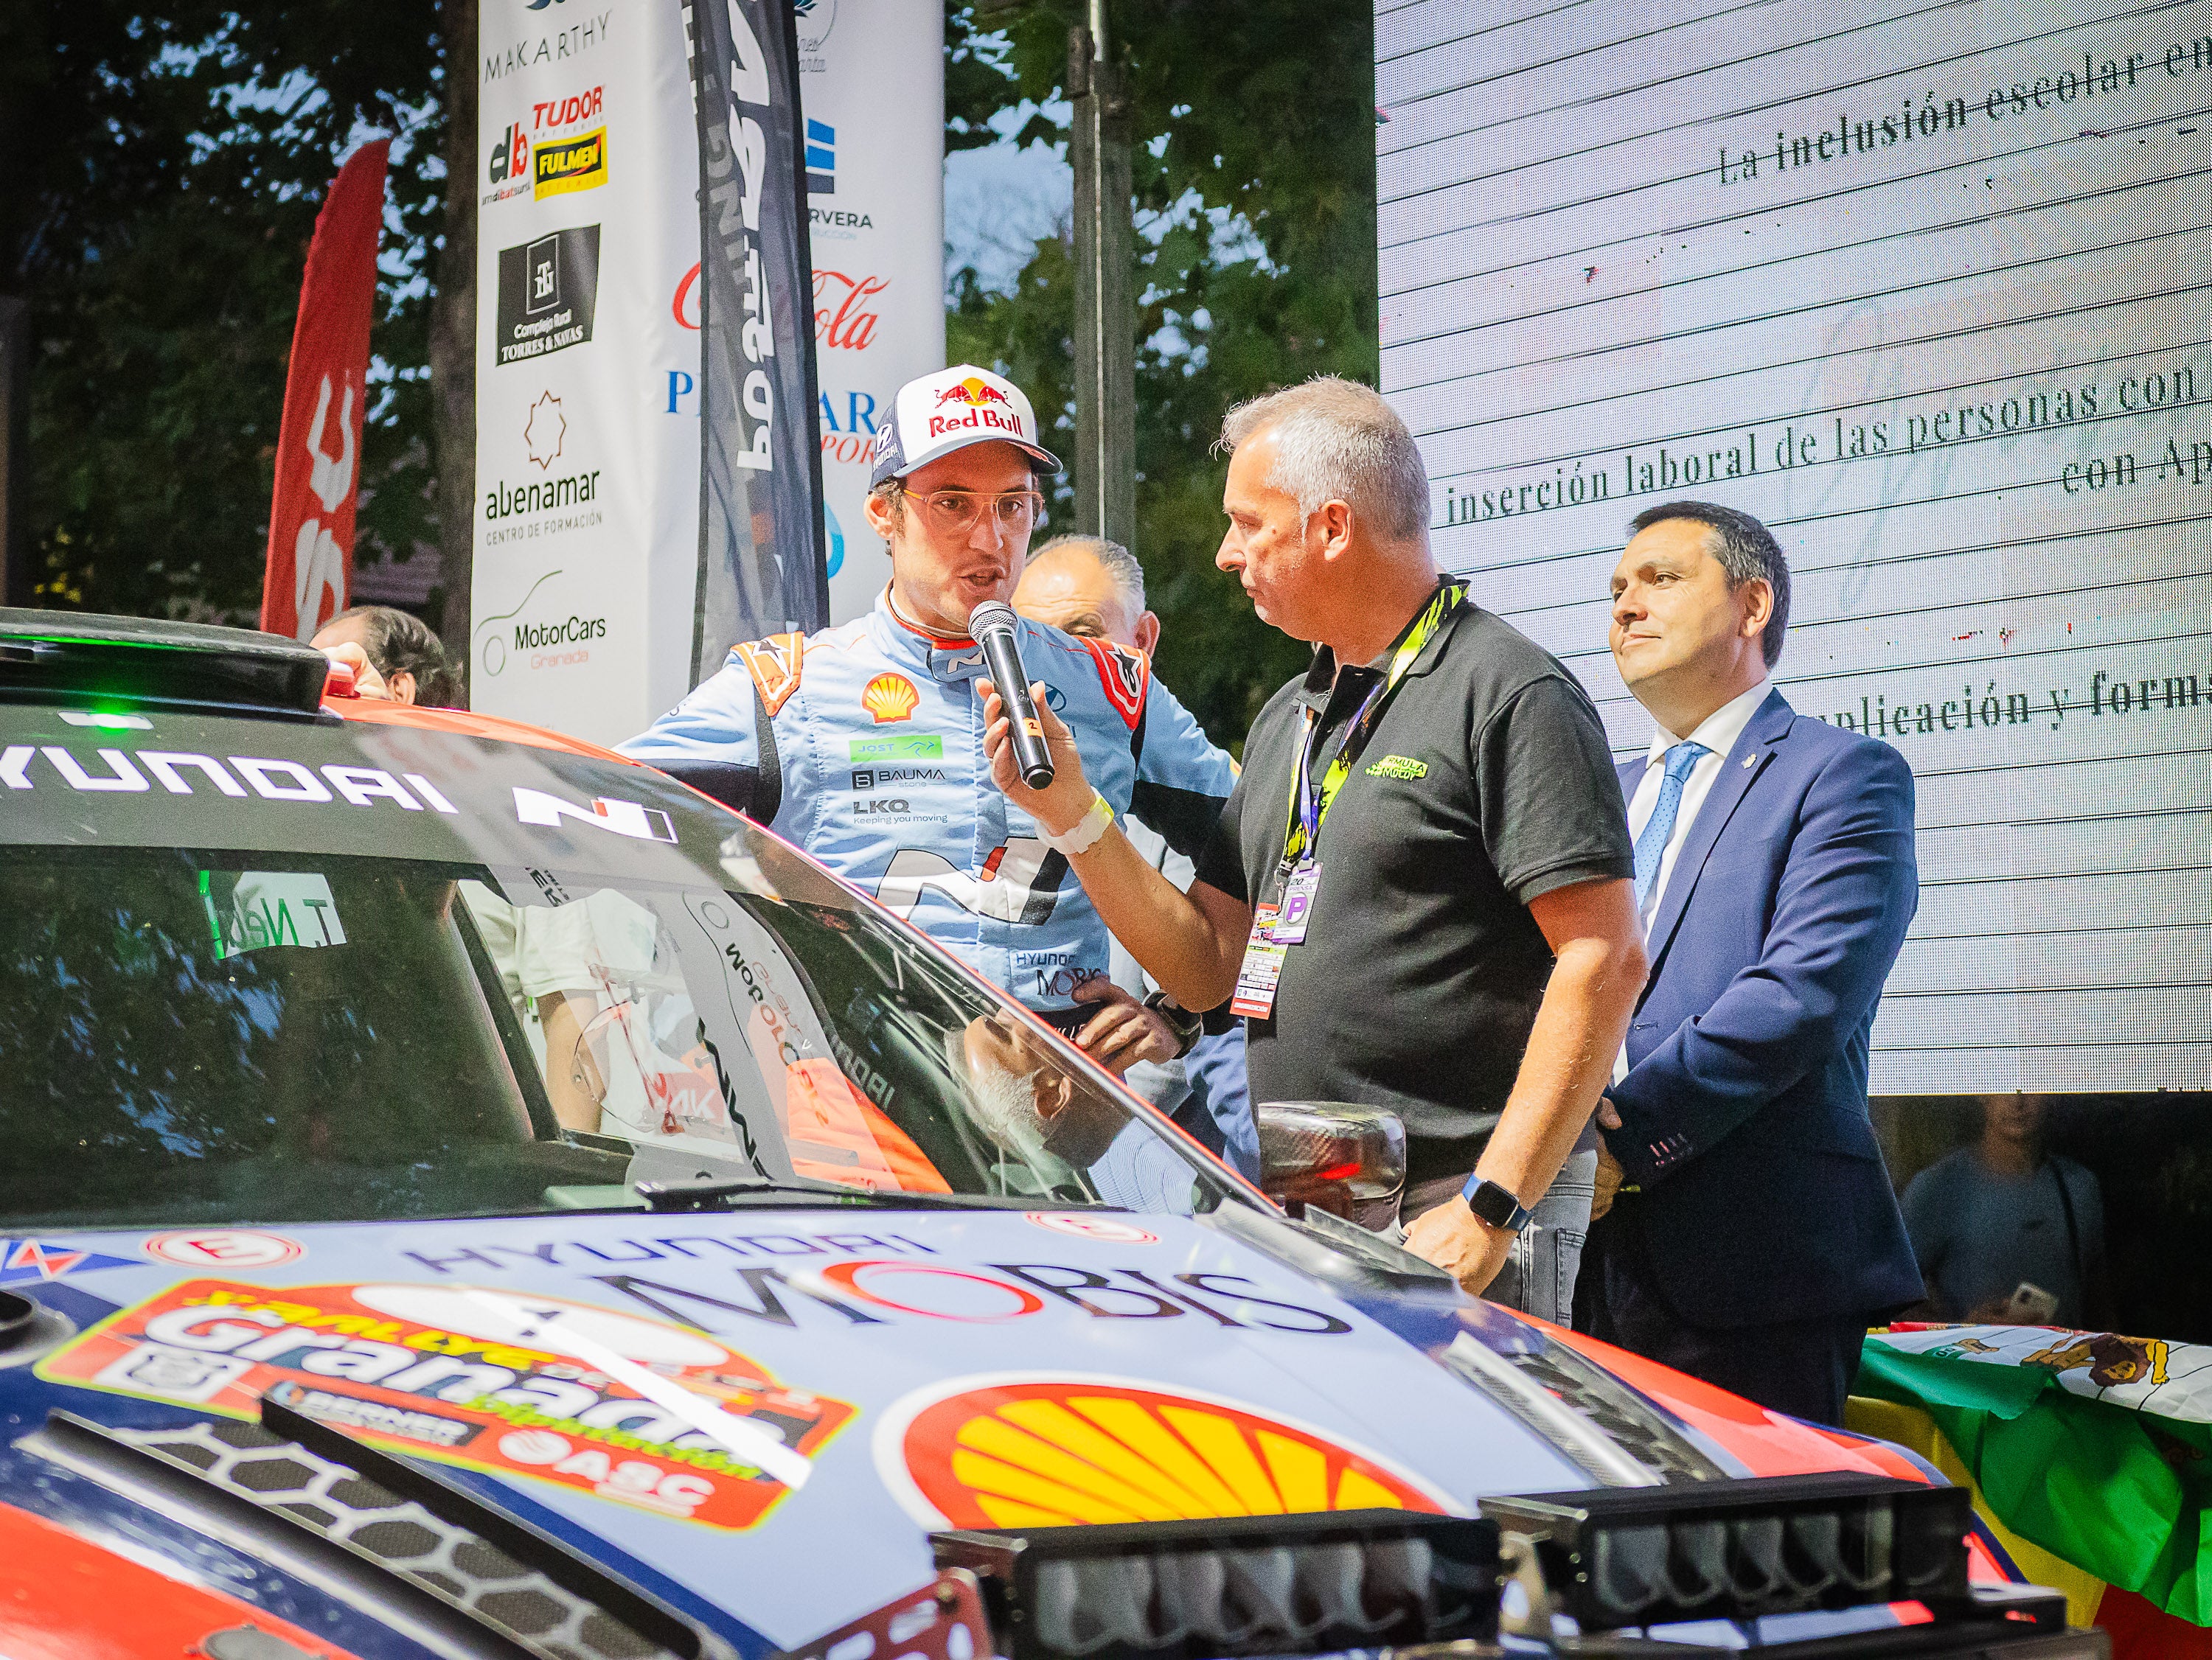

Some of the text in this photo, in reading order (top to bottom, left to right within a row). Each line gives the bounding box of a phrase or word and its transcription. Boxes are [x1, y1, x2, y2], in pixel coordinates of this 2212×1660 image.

[484, 10, 611, 83] MAKARTHY
[532, 86, 603, 130] TUDOR
[1720, 147, 1758, 184] La
[1776, 91, 1967, 170] inclusión
[1985, 54, 2144, 122] escolar
[539, 142, 599, 176] FULMEN
[809, 207, 874, 229] RVERA
[501, 338, 545, 361] TORRES
[554, 325, 583, 349] NAVAS
[514, 318, 553, 339] Complejo
[929, 408, 1024, 438] Red Bull
[1447, 368, 2195, 524] inserción laboral de las personas con
[2062, 453, 2137, 493] con
[486, 470, 600, 520] abenamar
[486, 509, 602, 547] CENTRO DE FORMACIÓN
[515, 616, 606, 650] MotorCars
[530, 649, 588, 669] Granada
[1819, 670, 2212, 738] licación y form
[858, 743, 895, 753] JOST
[0, 745, 459, 814] YUNDAI
[879, 769, 945, 781] BAUMA
[853, 798, 911, 815] LKQ
[854, 814, 948, 825] Keeping you moving
[1286, 896, 1307, 921] P
[403, 1234, 937, 1274] HYUNDAI
[585, 1261, 1354, 1334] MOBIS
[552, 1449, 716, 1506] ASC
